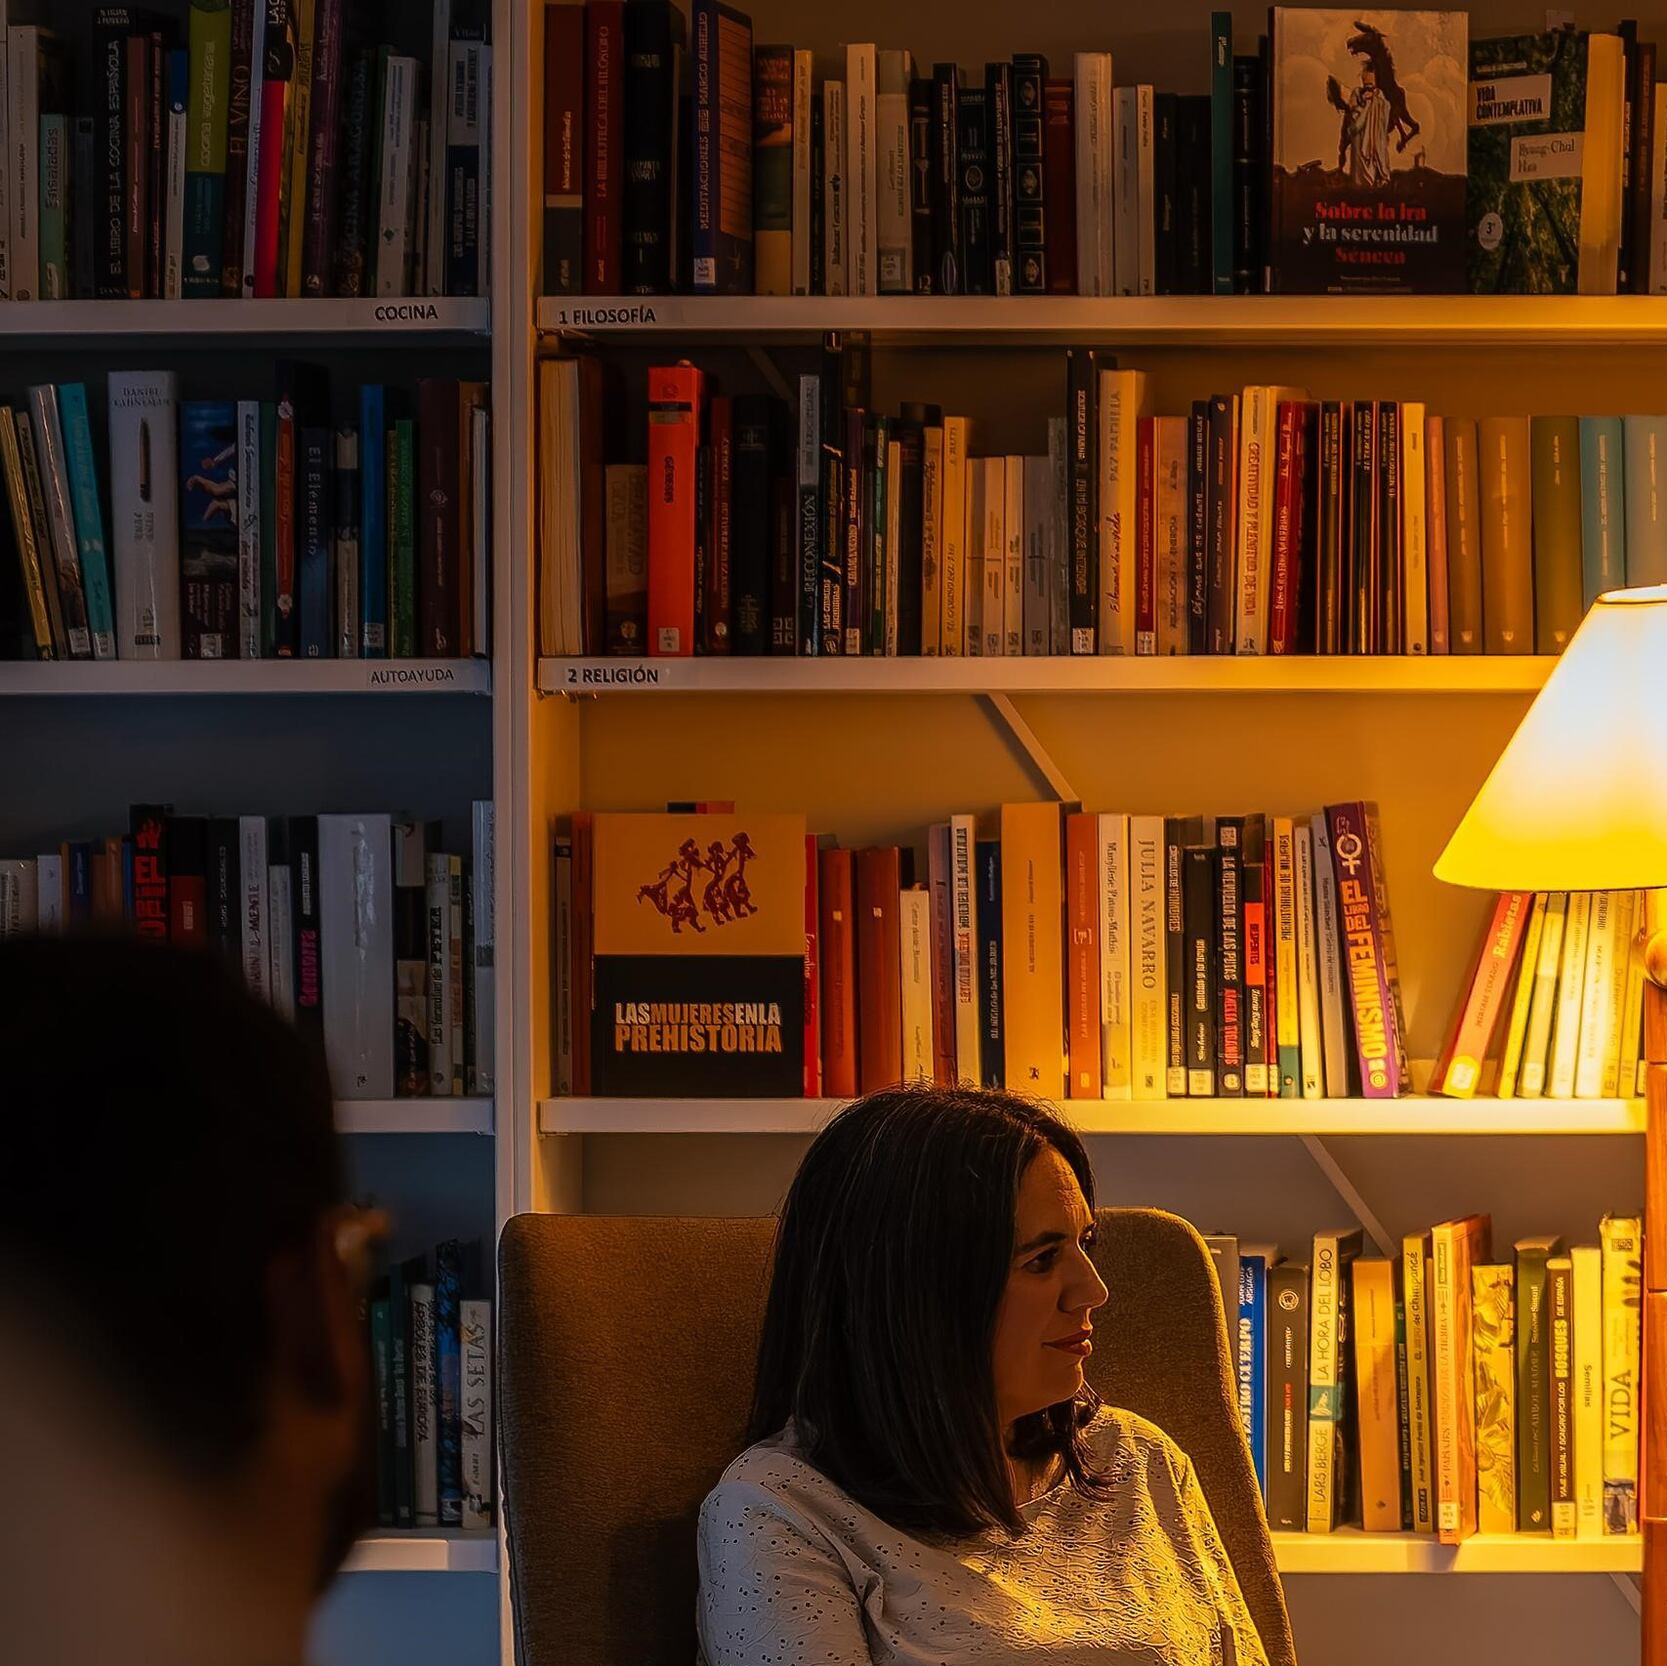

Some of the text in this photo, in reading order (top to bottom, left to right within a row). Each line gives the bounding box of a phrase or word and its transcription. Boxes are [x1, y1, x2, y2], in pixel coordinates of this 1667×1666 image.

[230, 63, 249, 125] VINO
[108, 115, 121, 168] COCINA
[109, 172, 121, 190] LA
[697, 136, 709, 230] MEDITACIONES
[109, 195, 121, 213] DE
[110, 217, 122, 256] LIBRO
[1303, 223, 1438, 245] y la serenidad
[110, 260, 122, 275] EL
[375, 304, 438, 322] COCINA
[559, 305, 656, 325] 1 FILOSOFÍA
[801, 495, 817, 593] RECONEXIÓN
[370, 670, 454, 684] AUTOAYUDA
[568, 665, 658, 683] 2 RELIGIÓN
[1341, 878, 1367, 904] EL
[1139, 840, 1156, 989] JULIA NAVARRO
[1347, 931, 1388, 1059] FEMINISMO
[615, 1025, 783, 1052] PREHISTORIA
[1313, 1248, 1332, 1381] LA HORA DEL LOBO
[465, 1322, 486, 1388] SETAS
[1238, 1318, 1252, 1382] CUERPO
[1584, 1364, 1593, 1408] Semillas
[1610, 1369, 1631, 1440] VIDA
[1313, 1428, 1328, 1503] LARS BERGE
